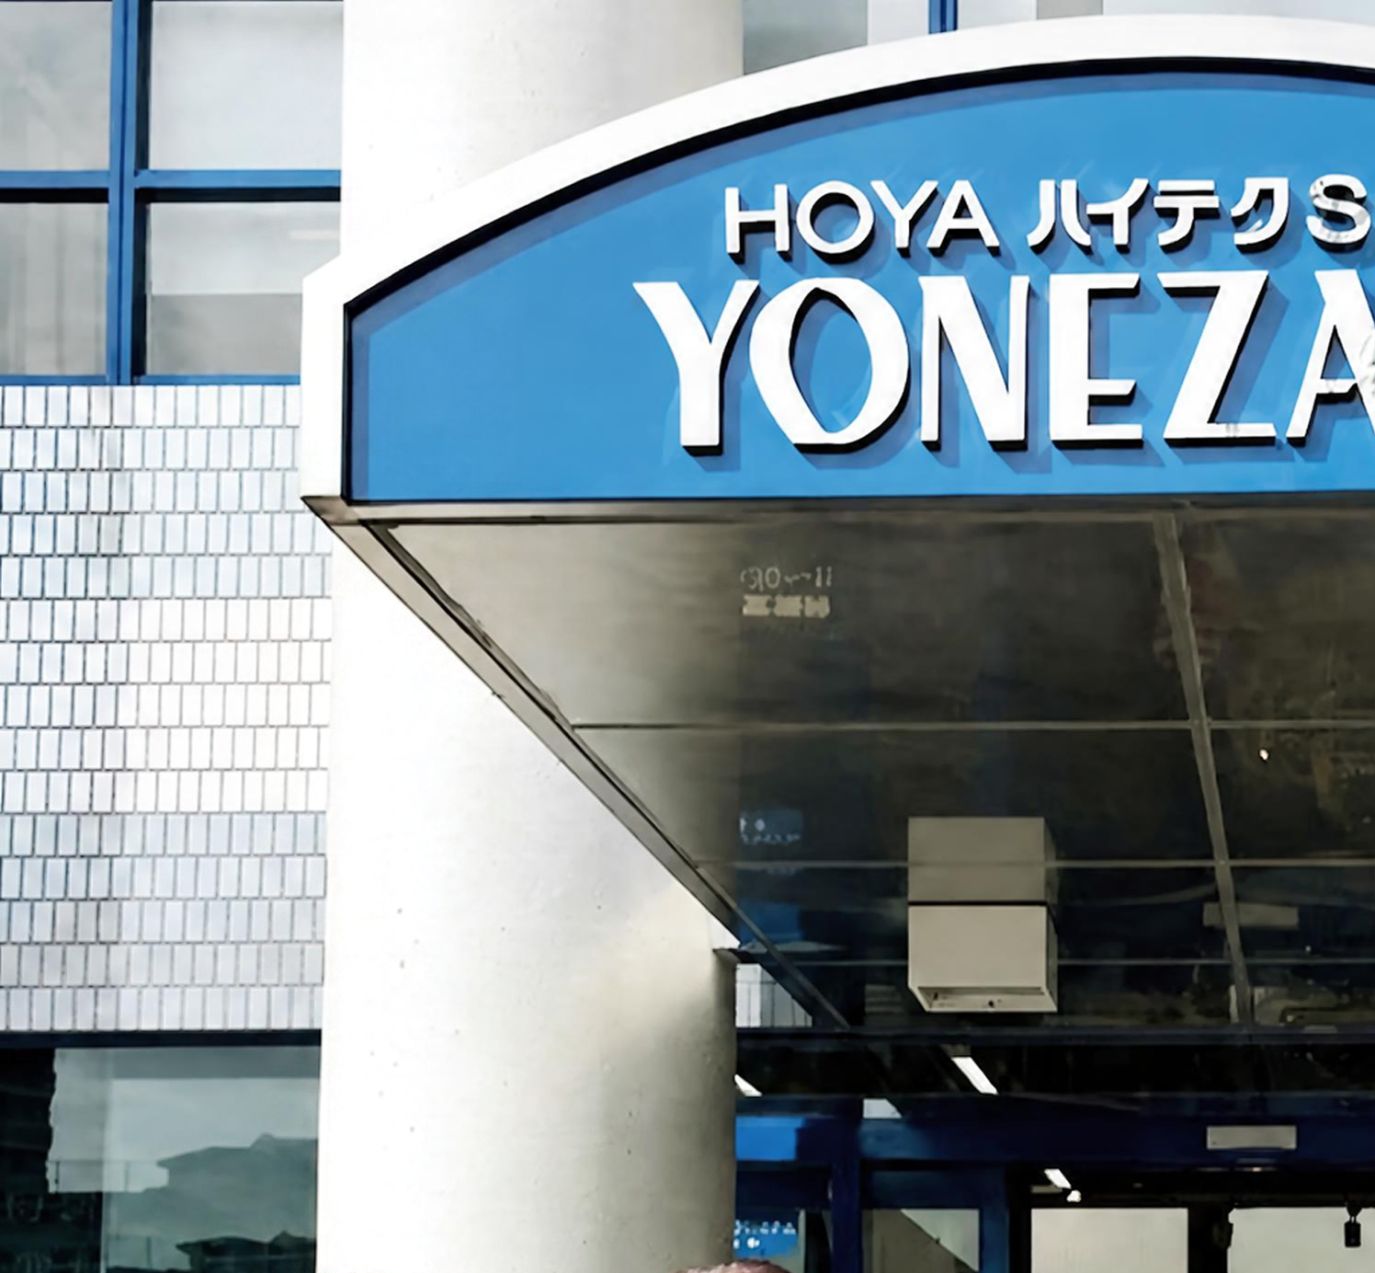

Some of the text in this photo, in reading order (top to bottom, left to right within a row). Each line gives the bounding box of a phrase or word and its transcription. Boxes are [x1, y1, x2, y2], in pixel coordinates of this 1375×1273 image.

[724, 179, 1000, 255] HOYA
[1027, 177, 1290, 248] ハイテク
